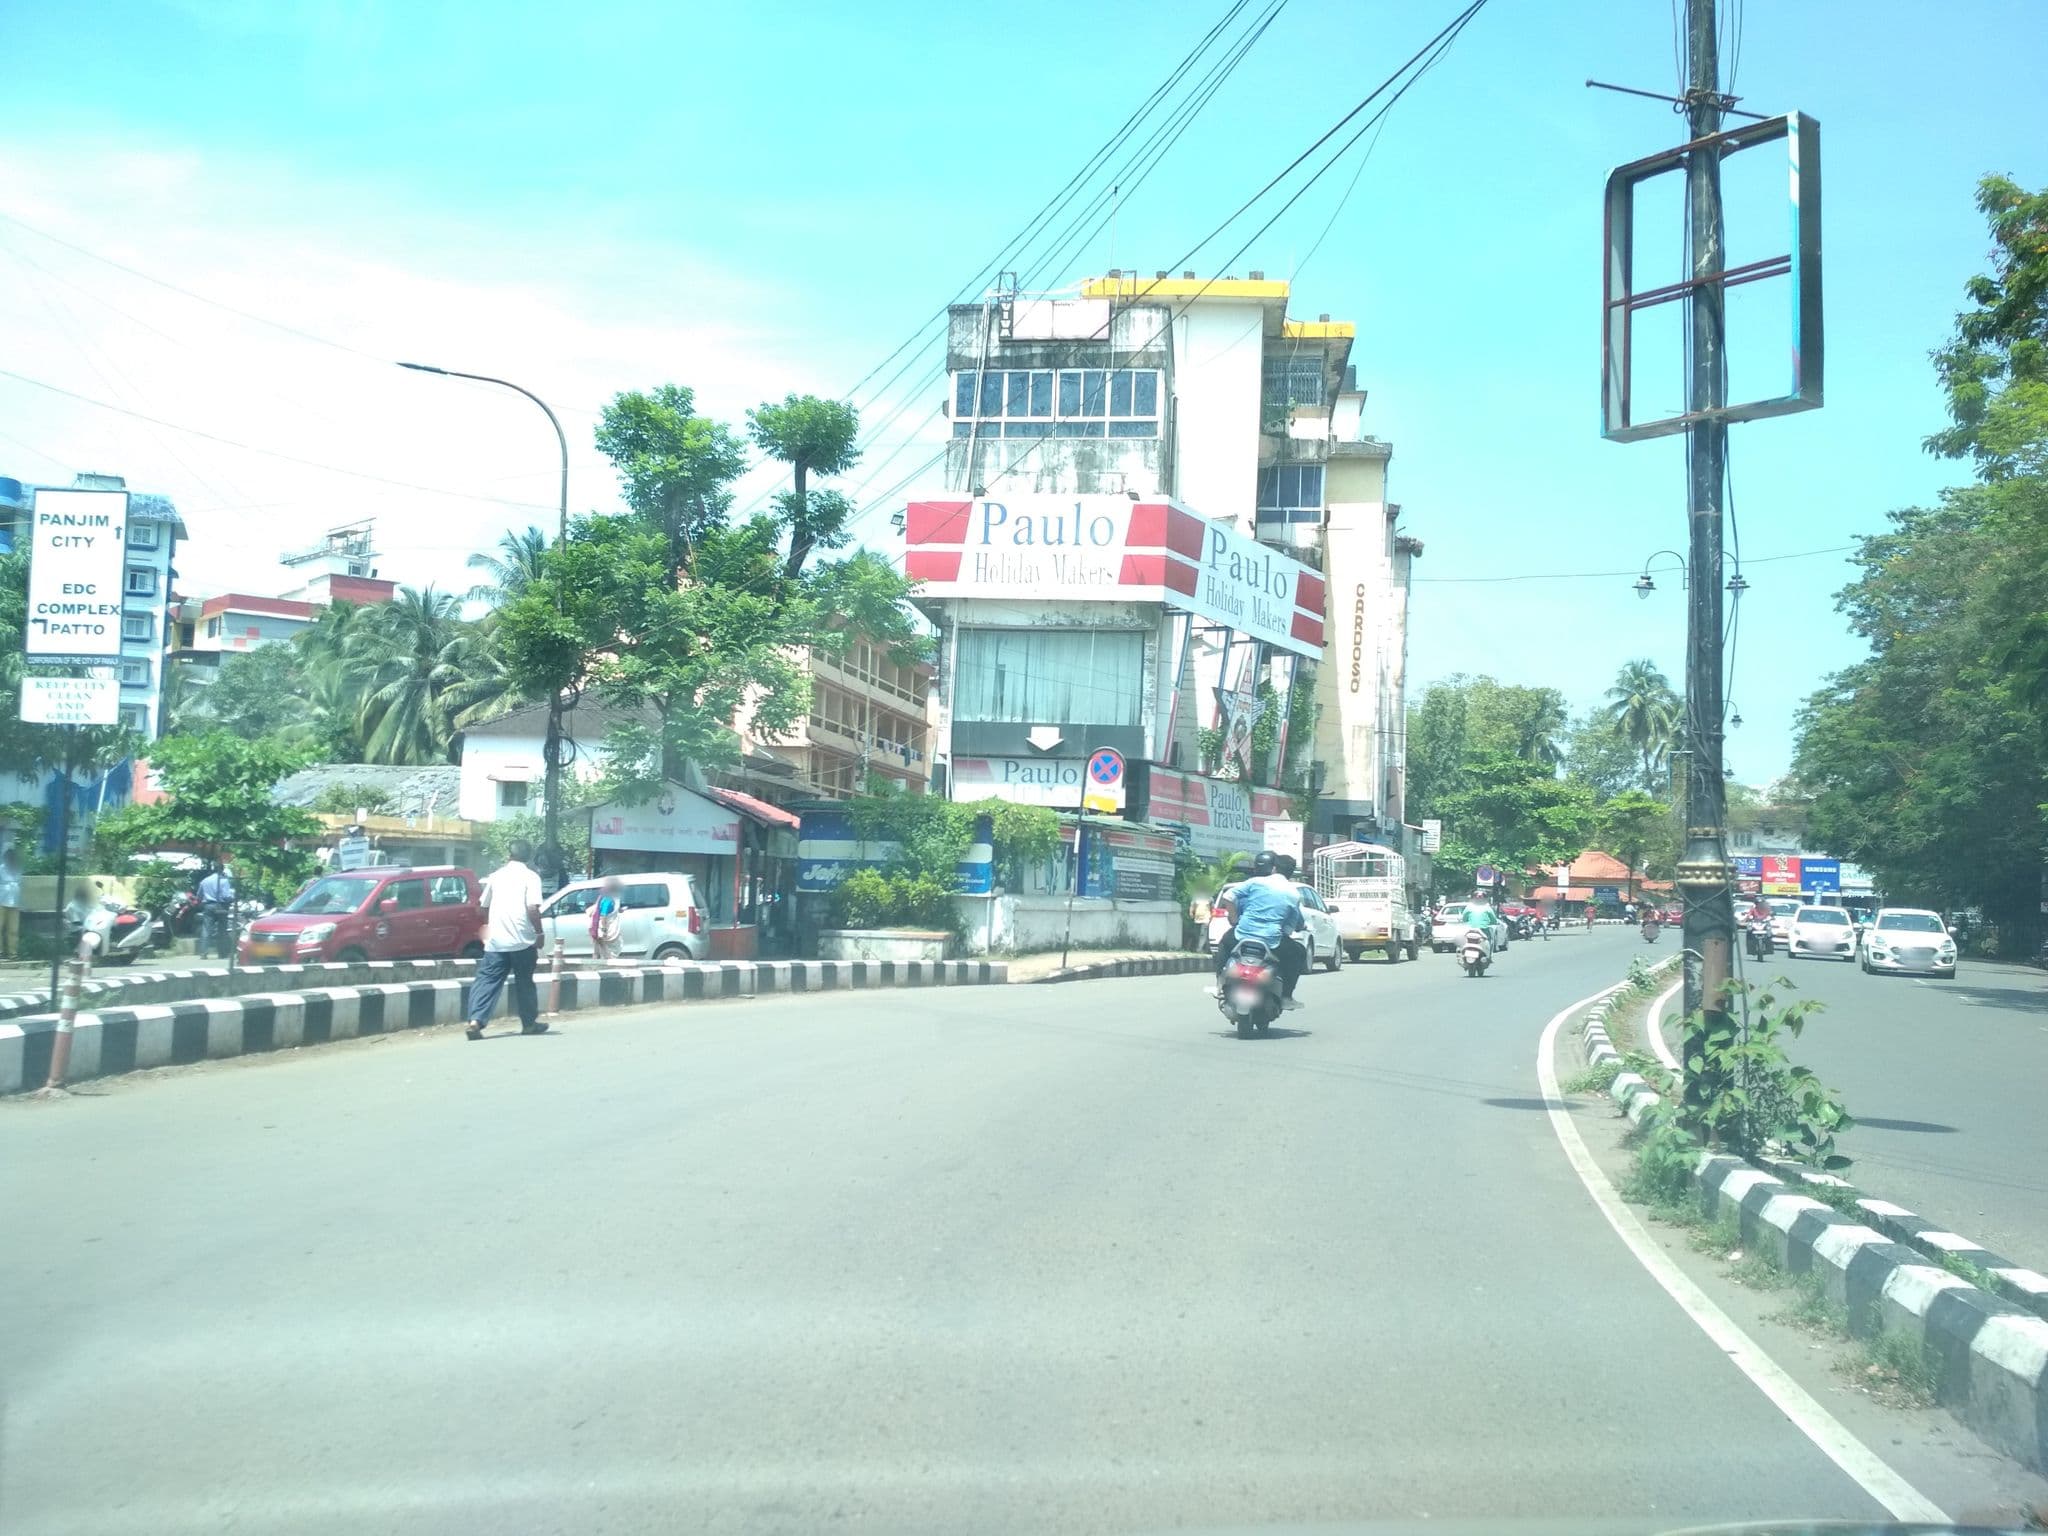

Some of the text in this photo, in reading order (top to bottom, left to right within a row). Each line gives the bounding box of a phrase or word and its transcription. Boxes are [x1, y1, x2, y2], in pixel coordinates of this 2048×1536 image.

[39, 513, 110, 527] PANJIM
[981, 501, 1115, 547] Paulo
[51, 536, 95, 548] CITY
[975, 552, 1114, 586] Holiday Makers
[1210, 526, 1288, 600] Paulo
[62, 584, 97, 595] EDC
[37, 603, 120, 616] COMPLEX
[1206, 577, 1287, 636] Holiday Makers
[51, 624, 105, 635] PATTO
[1350, 583, 1366, 694] CARDOSO
[74, 682, 106, 690] CITY
[48, 692, 92, 700] CLEAN
[56, 702, 85, 710] AND
[46, 712, 91, 720] GREEN
[1002, 760, 1078, 785] Paulo
[1210, 785, 1242, 812] Paulo
[1213, 809, 1250, 832] travels
